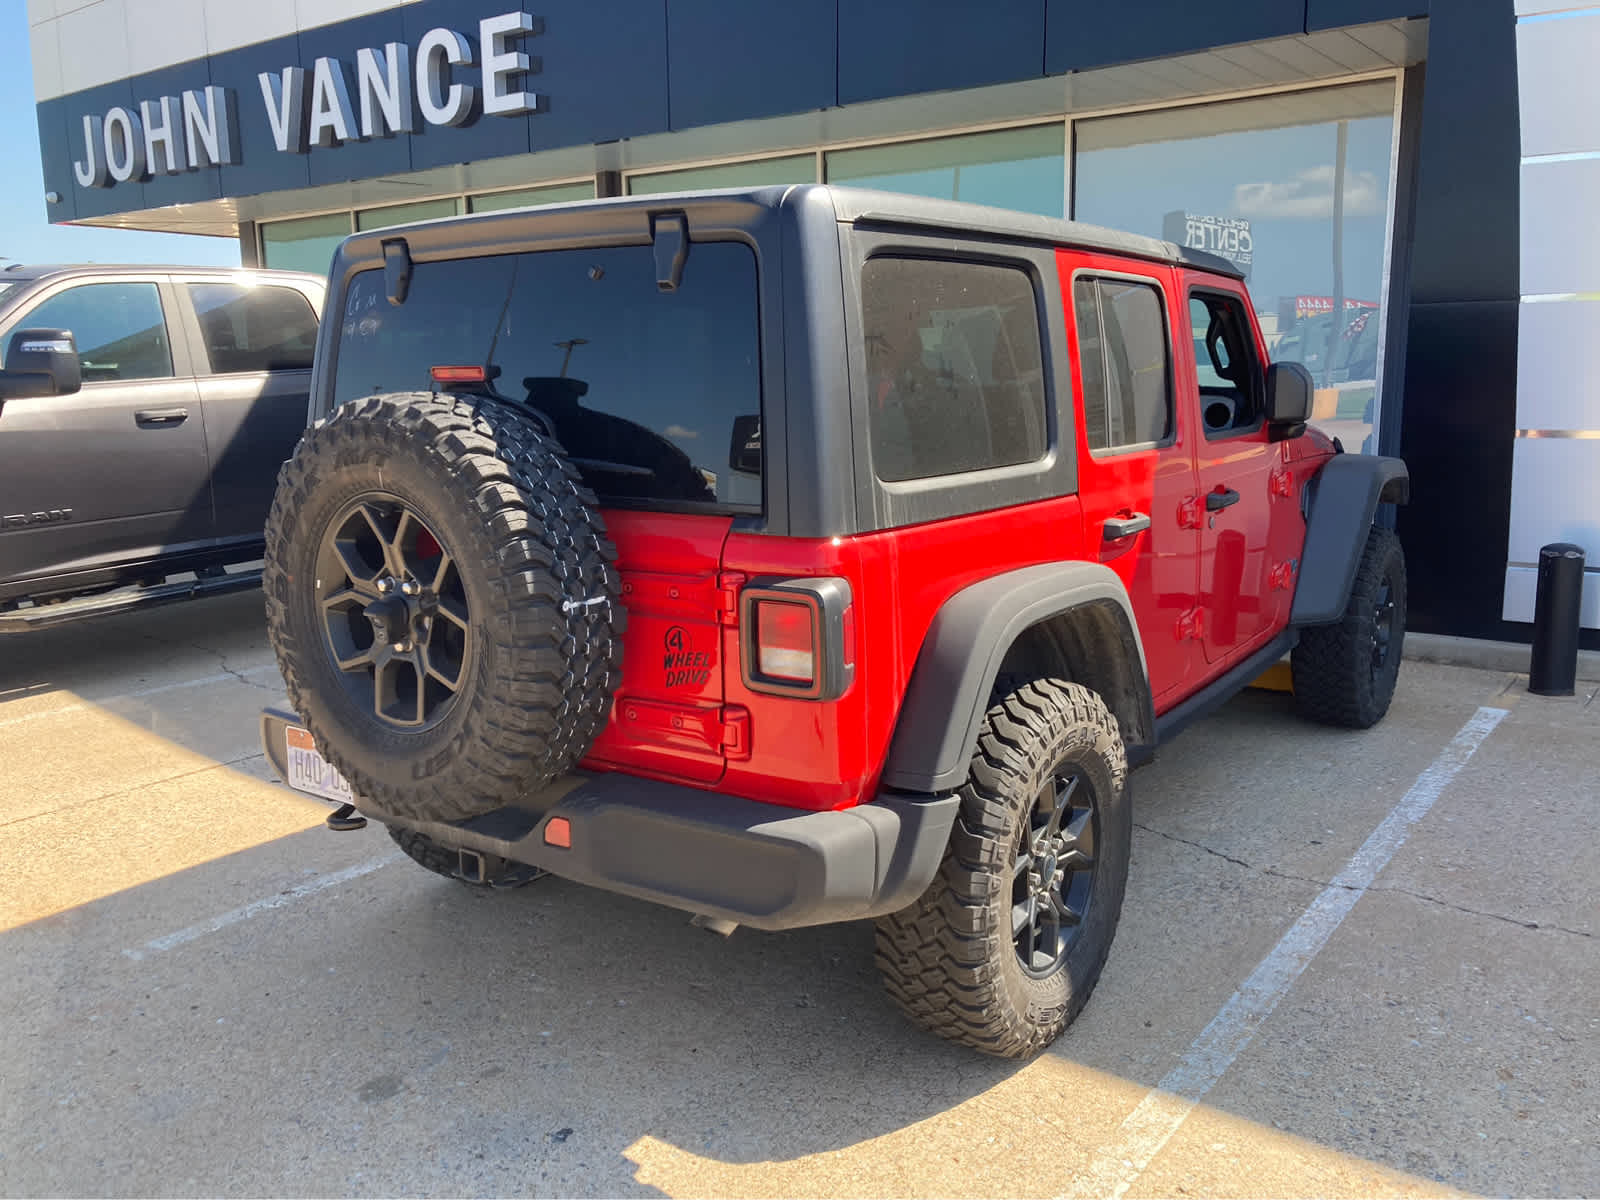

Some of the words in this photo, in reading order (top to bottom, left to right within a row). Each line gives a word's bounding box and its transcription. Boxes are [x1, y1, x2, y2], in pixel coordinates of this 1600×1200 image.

[74, 86, 233, 188] JOHN
[258, 11, 537, 153] VANCE
[664, 651, 710, 670] WHEEL
[666, 669, 710, 688] DRIVE
